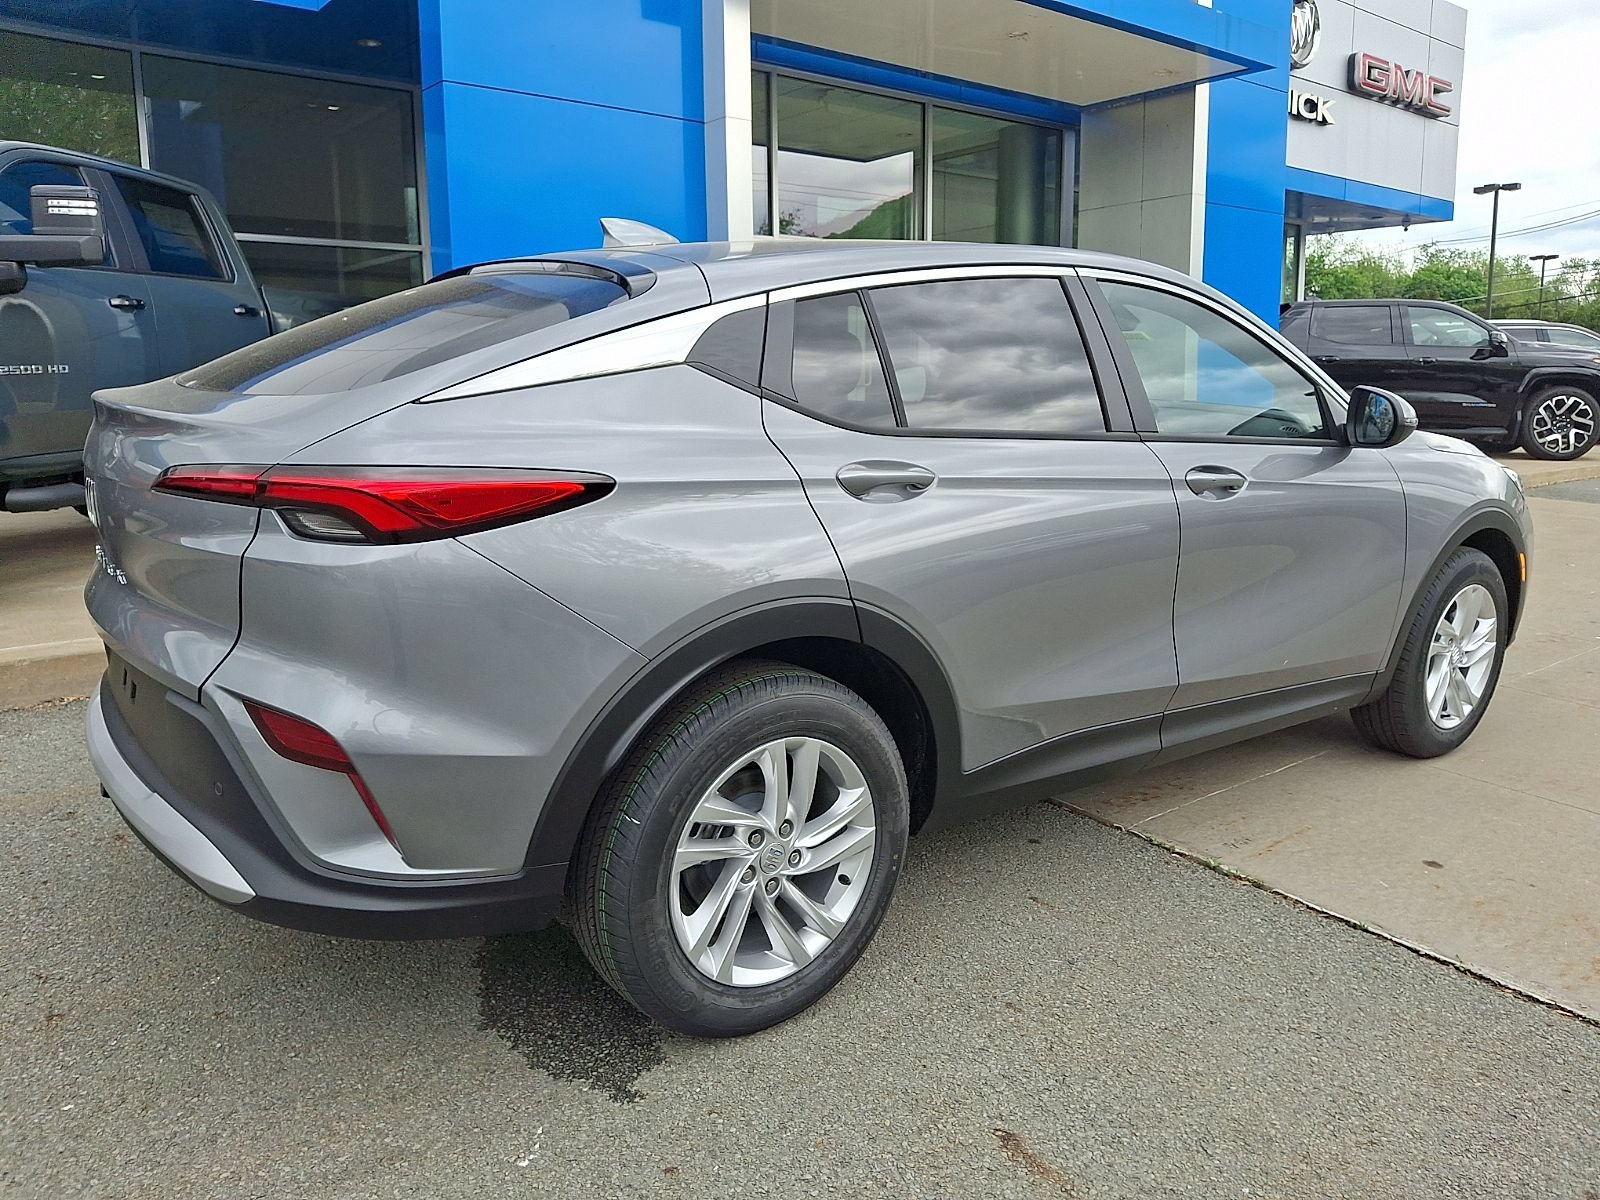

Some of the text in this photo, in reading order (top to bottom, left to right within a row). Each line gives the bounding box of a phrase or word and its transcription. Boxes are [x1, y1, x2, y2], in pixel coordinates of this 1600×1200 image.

[1349, 52, 1453, 117] GMC
[1288, 89, 1337, 125] ICK
[0, 364, 69, 375] 2500 HD
